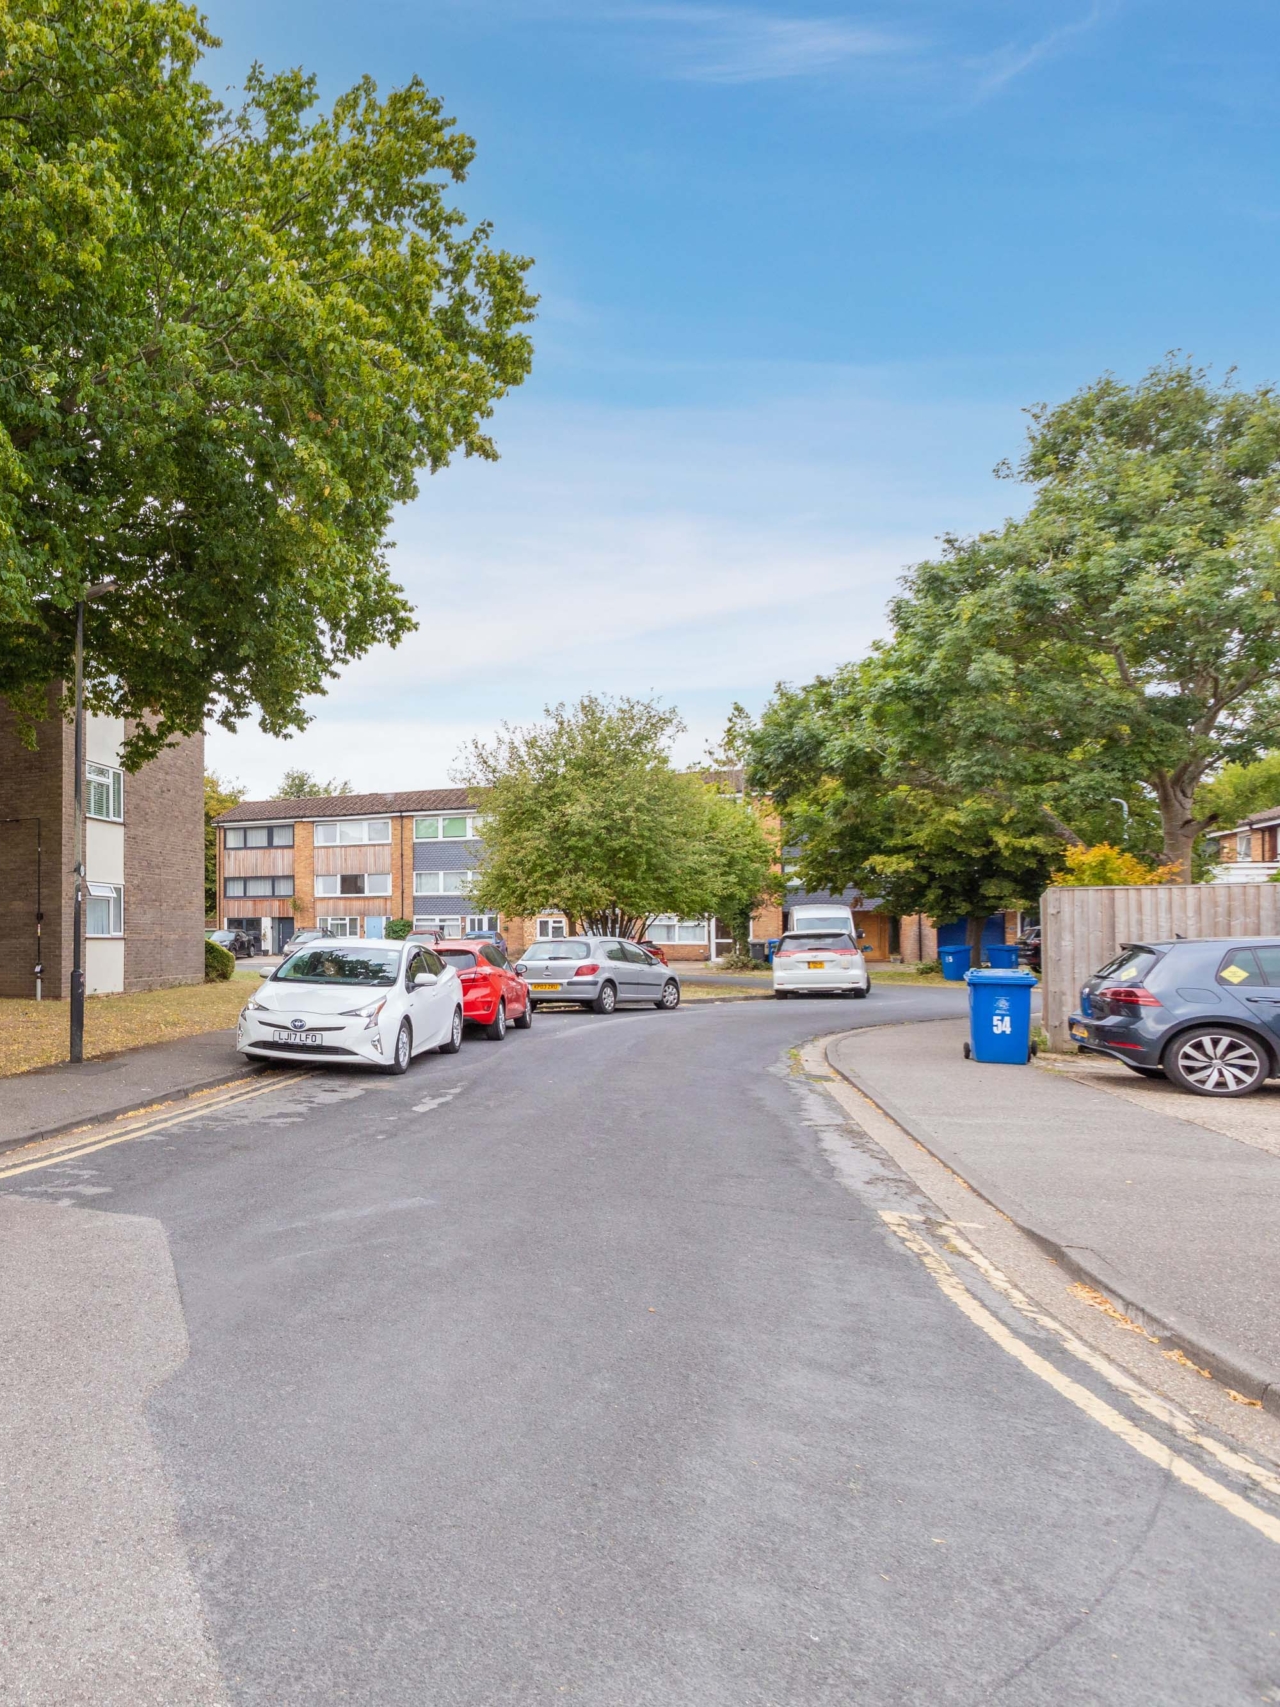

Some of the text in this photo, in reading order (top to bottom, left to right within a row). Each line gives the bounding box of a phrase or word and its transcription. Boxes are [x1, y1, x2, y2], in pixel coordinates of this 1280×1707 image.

[992, 1015, 1011, 1034] 54
[278, 1032, 317, 1043] LJ17 LFO
